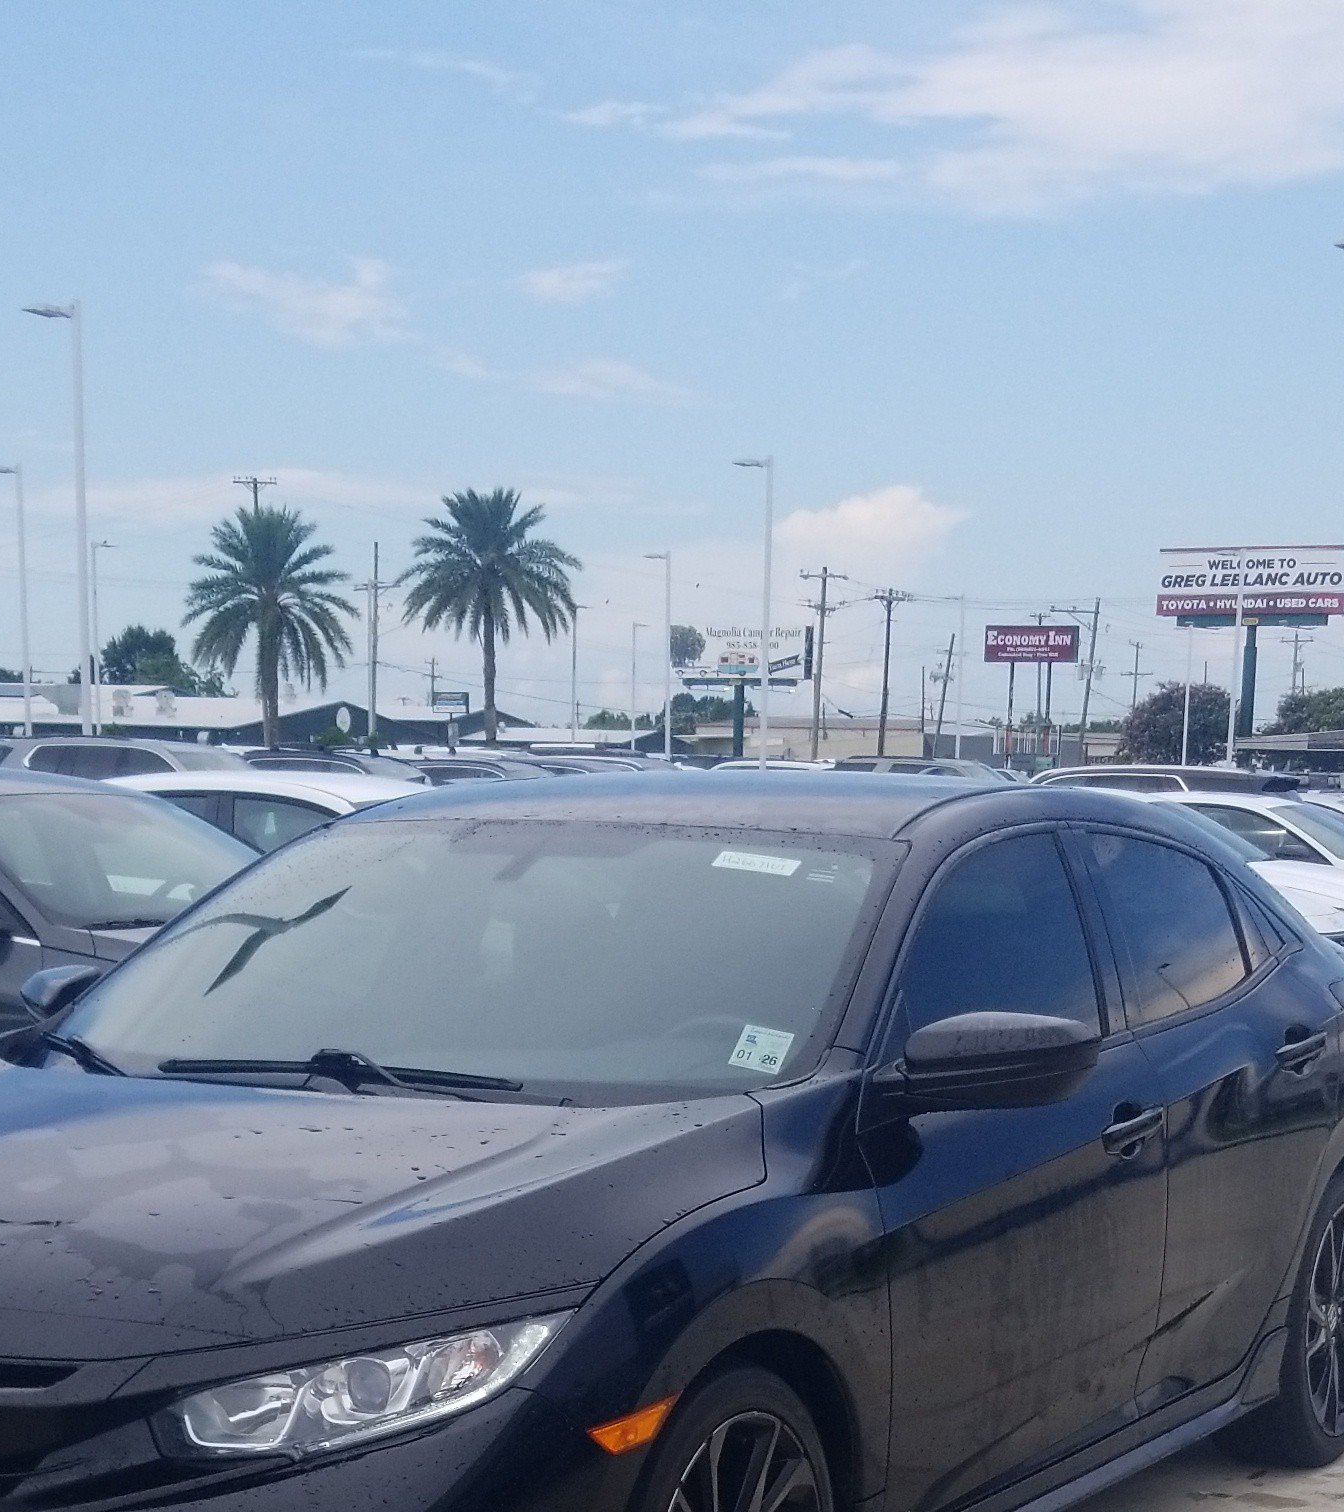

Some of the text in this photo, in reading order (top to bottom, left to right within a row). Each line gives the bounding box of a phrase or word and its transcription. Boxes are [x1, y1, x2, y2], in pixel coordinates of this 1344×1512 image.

[1278, 558, 1296, 569] TO
[1161, 571, 1343, 588] GREG LEBLANC AUTO
[1161, 597, 1339, 610] TOYOTA HYUNDAI USED CARS
[706, 626, 802, 640] Magnolia Camr Repair
[986, 630, 1072, 646] ECONOMY INN
[726, 641, 779, 650] 985-858-00
[736, 1049, 778, 1066] 01 26
